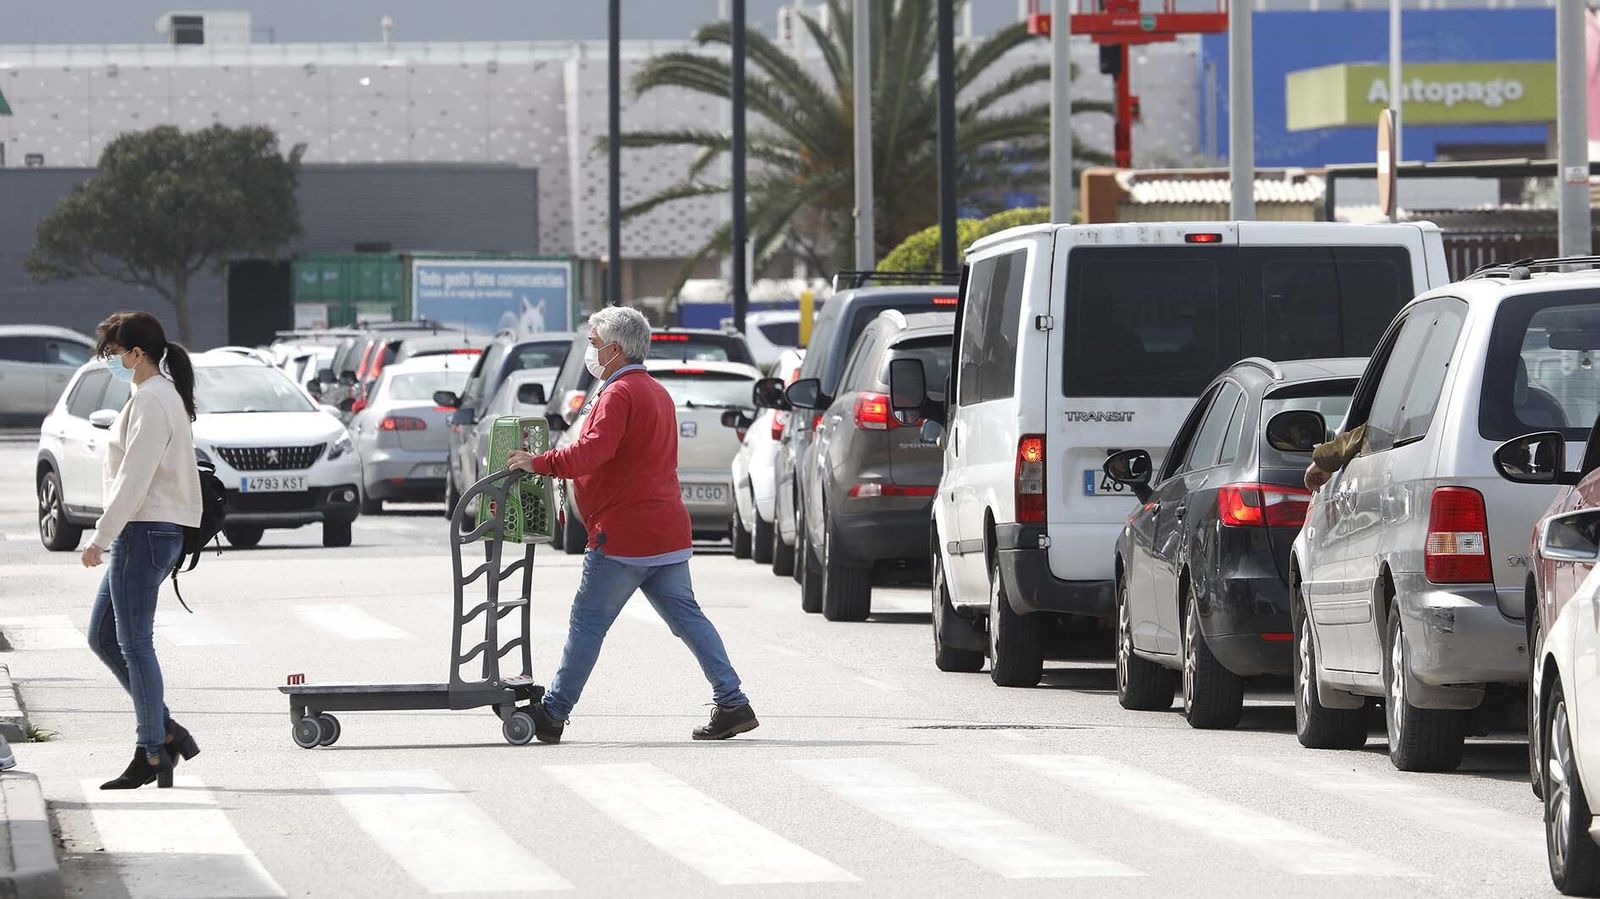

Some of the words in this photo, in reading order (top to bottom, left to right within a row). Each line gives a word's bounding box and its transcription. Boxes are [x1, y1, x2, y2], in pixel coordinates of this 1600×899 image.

[419, 271, 443, 286] Todo
[444, 272, 471, 289] gesto
[1065, 411, 1135, 422] TRANSIT
[249, 478, 279, 490] 4793
[282, 477, 304, 489] KST
